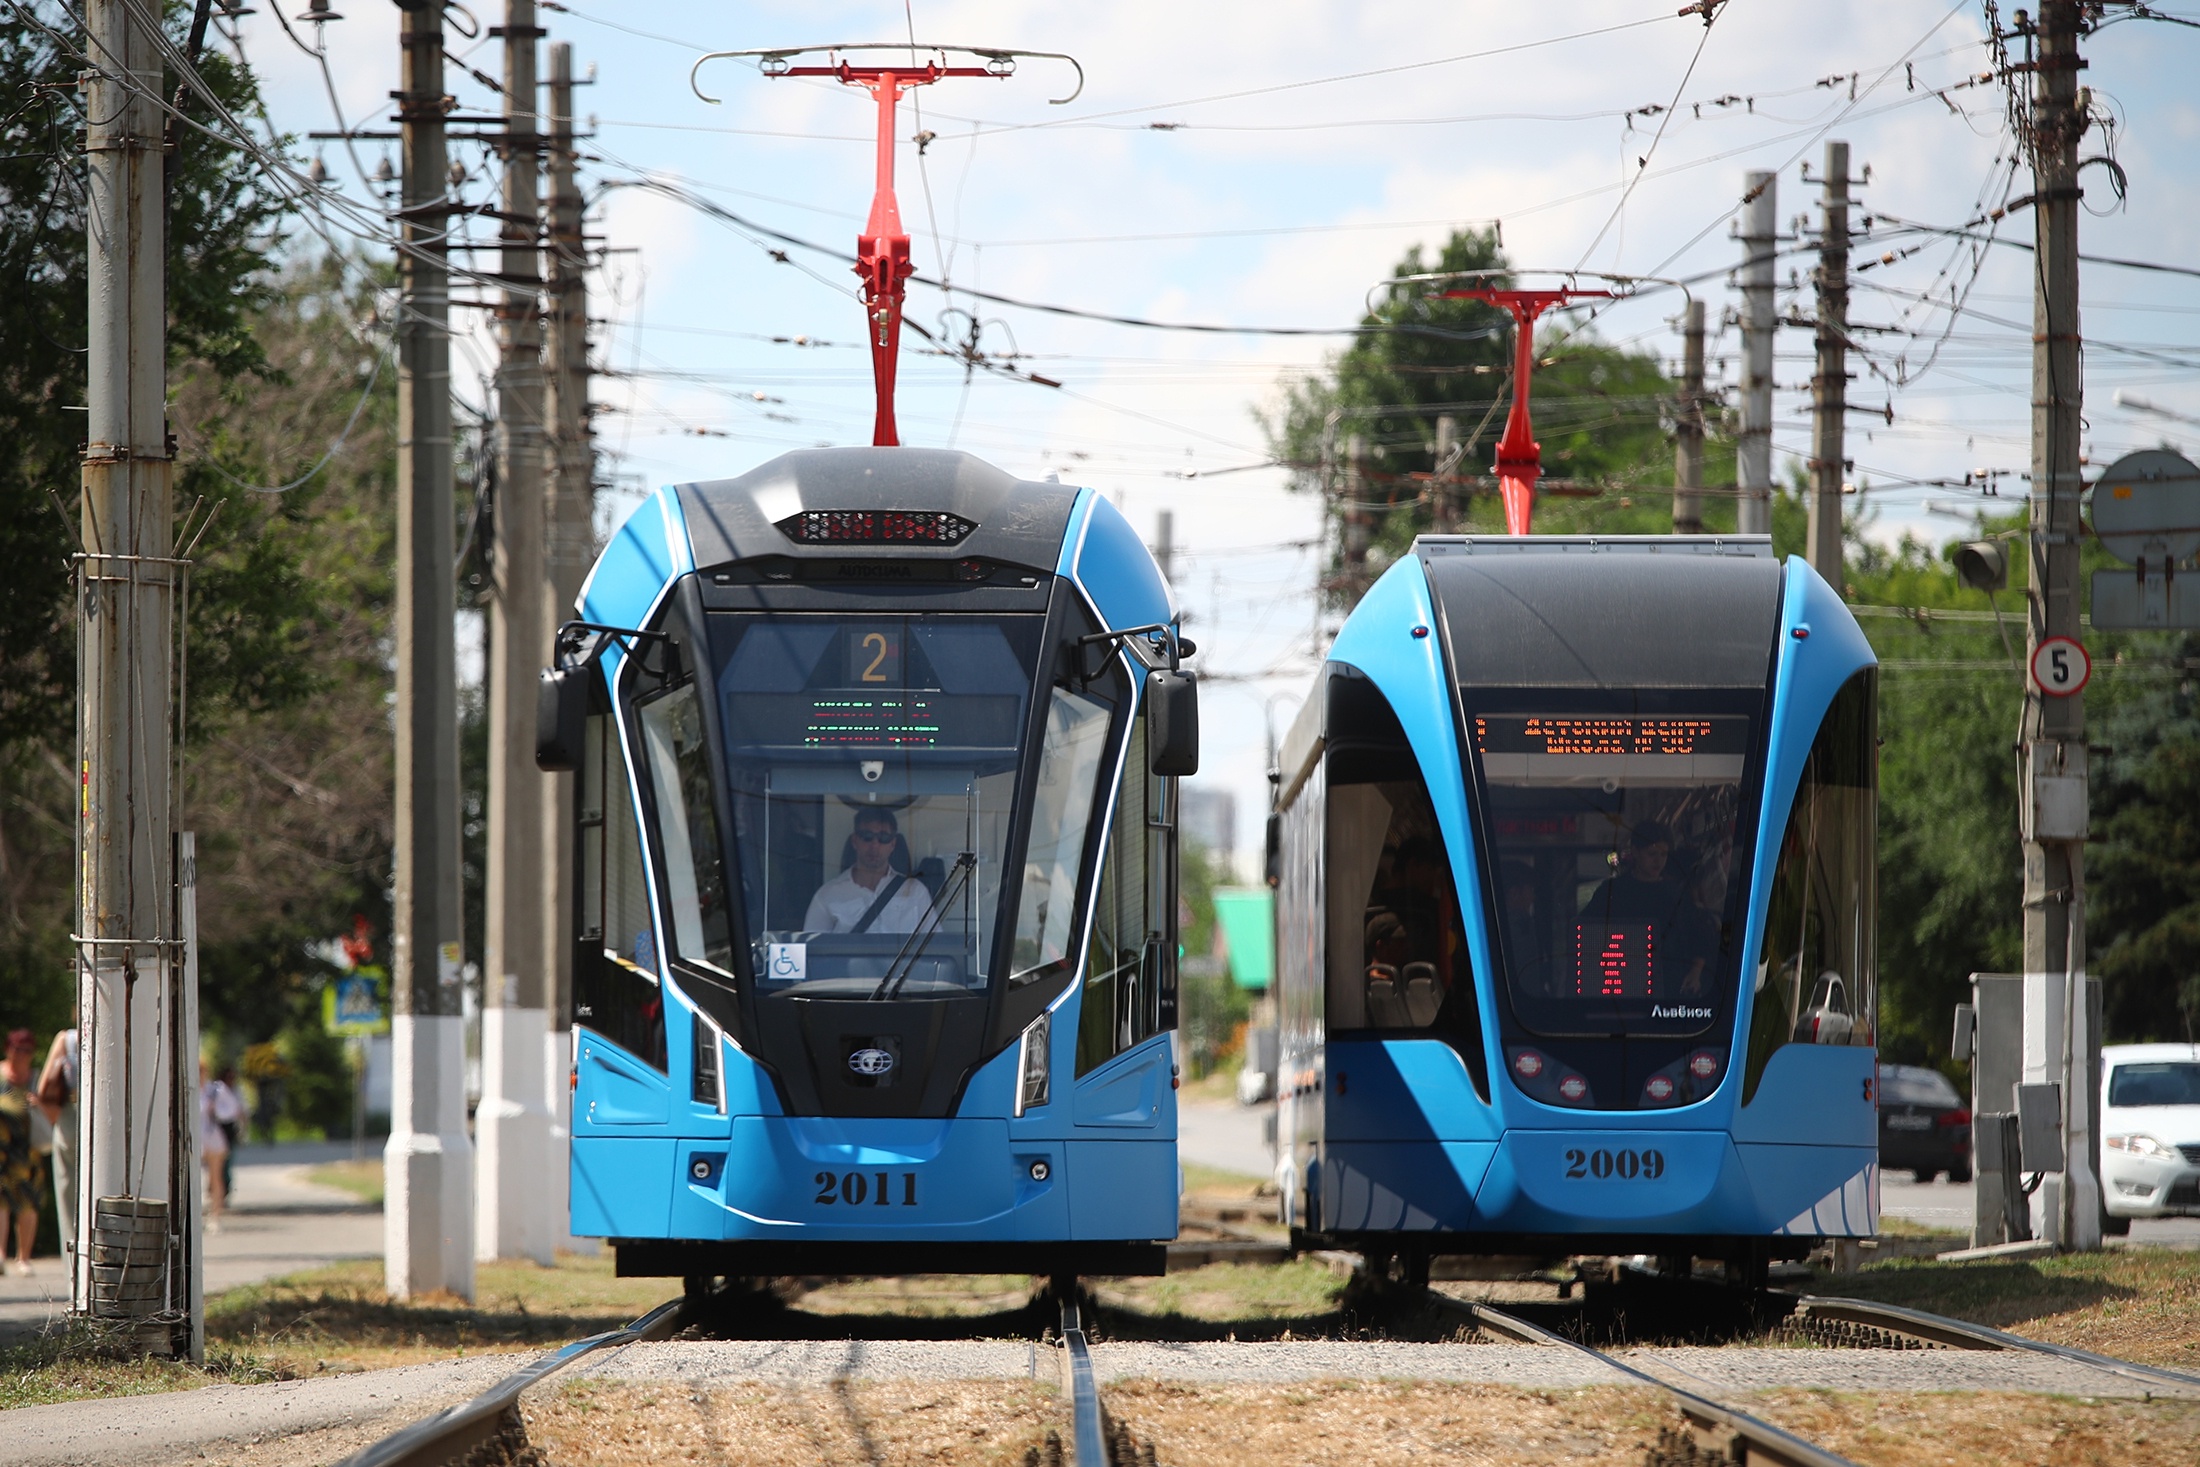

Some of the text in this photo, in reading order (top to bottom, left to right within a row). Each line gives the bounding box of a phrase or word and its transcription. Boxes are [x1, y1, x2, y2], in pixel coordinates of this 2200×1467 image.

[862, 633, 887, 682] 2
[2052, 649, 2069, 683] 5
[1651, 1004, 1712, 1018] Львёнок
[1565, 1148, 1664, 1179] 2009
[814, 1171, 918, 1205] 2011
